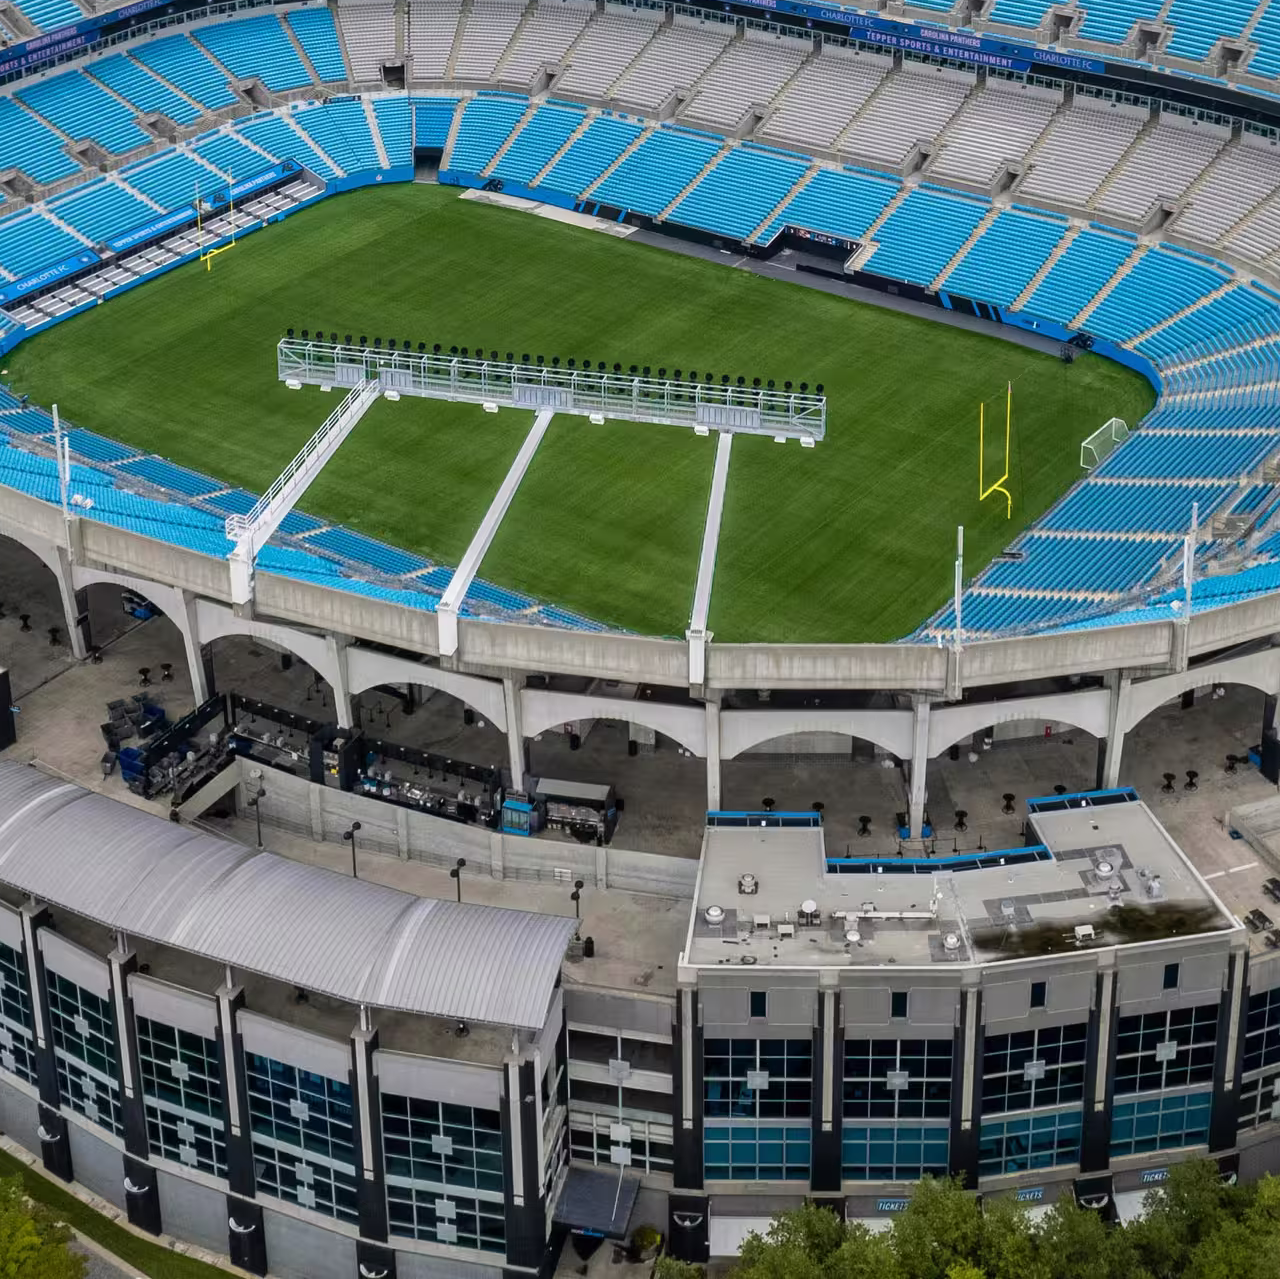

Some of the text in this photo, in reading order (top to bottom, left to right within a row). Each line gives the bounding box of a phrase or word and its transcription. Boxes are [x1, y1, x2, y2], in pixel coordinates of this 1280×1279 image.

[118, 1, 154, 18] CHARLOTTE
[821, 9, 874, 27] CHARLOTTE FC
[920, 29, 981, 48] CAROLINA PANTHERS
[21, 56, 26, 65] &
[28, 36, 85, 64] ENTERTAINMENT
[866, 31, 1013, 68] TEPPER SPORTS & ENTERTAINMENT
[1033, 51, 1093, 70] CHARLOTTE FC
[17, 264, 70, 291] CHARLOTTE FC
